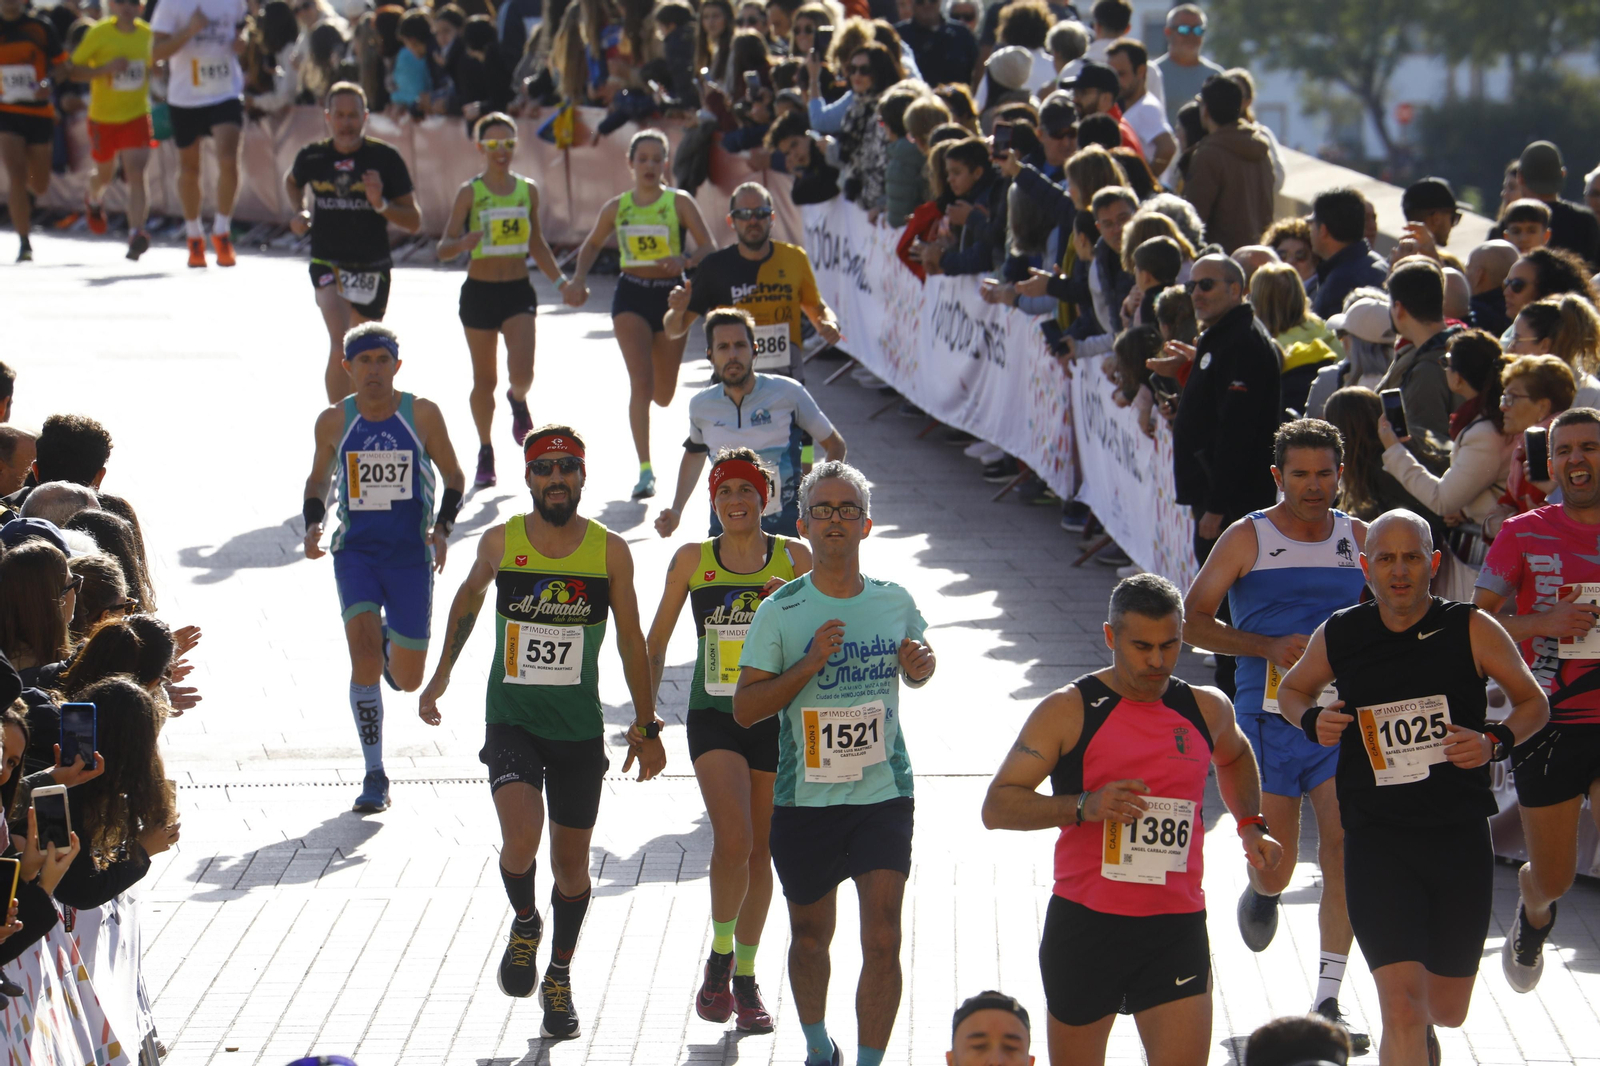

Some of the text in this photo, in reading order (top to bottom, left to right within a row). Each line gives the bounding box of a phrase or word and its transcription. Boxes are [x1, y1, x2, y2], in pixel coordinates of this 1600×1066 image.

[502, 219, 519, 234] 54
[638, 236, 657, 251] 53
[340, 273, 376, 290] 2268
[359, 463, 409, 483] 2037
[529, 625, 560, 636] IMDECO
[526, 639, 572, 665] 537
[829, 709, 862, 718] IMDECO
[1383, 702, 1417, 715] IMDECO
[822, 718, 878, 749] 1521
[1379, 712, 1448, 748] 1025
[1367, 731, 1379, 757] CAJÓN
[1402, 746, 1416, 754] JESUS
[1416, 744, 1433, 752] MOLINA
[1109, 820, 1118, 850] CAJÓN
[1125, 816, 1190, 849] 1386
